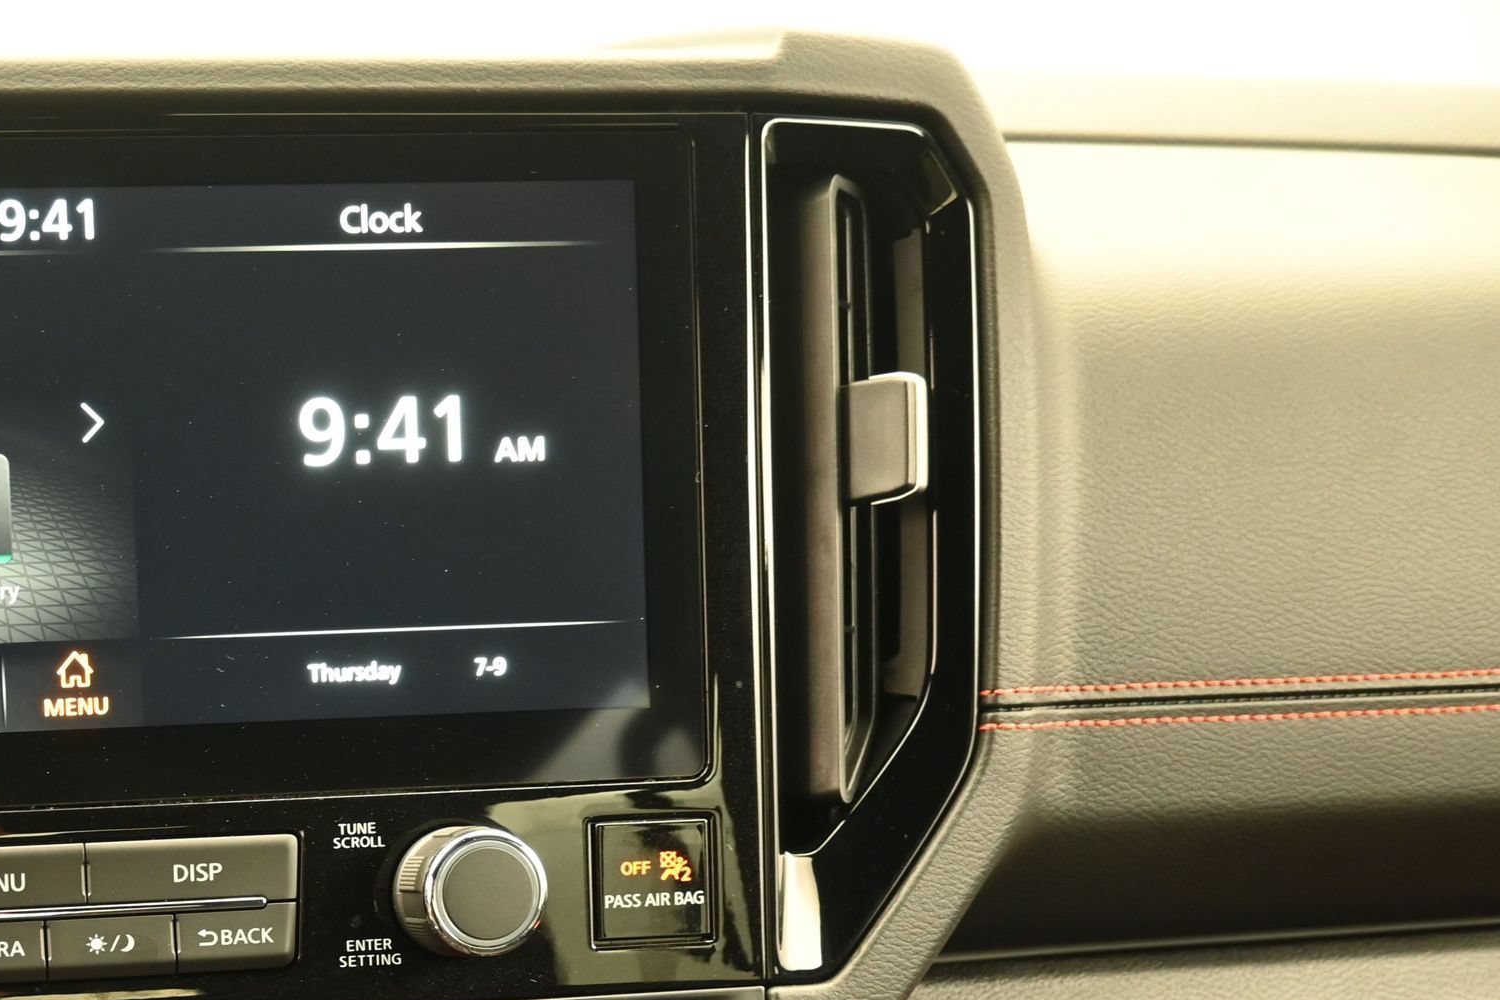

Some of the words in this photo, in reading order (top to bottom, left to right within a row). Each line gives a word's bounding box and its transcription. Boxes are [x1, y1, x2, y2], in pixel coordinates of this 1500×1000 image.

[339, 203, 423, 235] Clock
[299, 393, 464, 468] 9:41
[494, 435, 546, 464] AM
[307, 660, 402, 685] Thursday
[474, 656, 508, 677] 7-9
[43, 696, 110, 719] MENU
[338, 822, 377, 836] TUNE
[332, 835, 386, 850] SCROLL
[173, 863, 223, 884] DISP
[620, 860, 652, 876] OFF
[604, 893, 642, 909] PASS
[644, 892, 671, 907] AIR
[674, 890, 705, 906] BAG
[220, 927, 274, 946] BACK
[346, 938, 393, 953] ENTER
[339, 953, 402, 969] SETTING
